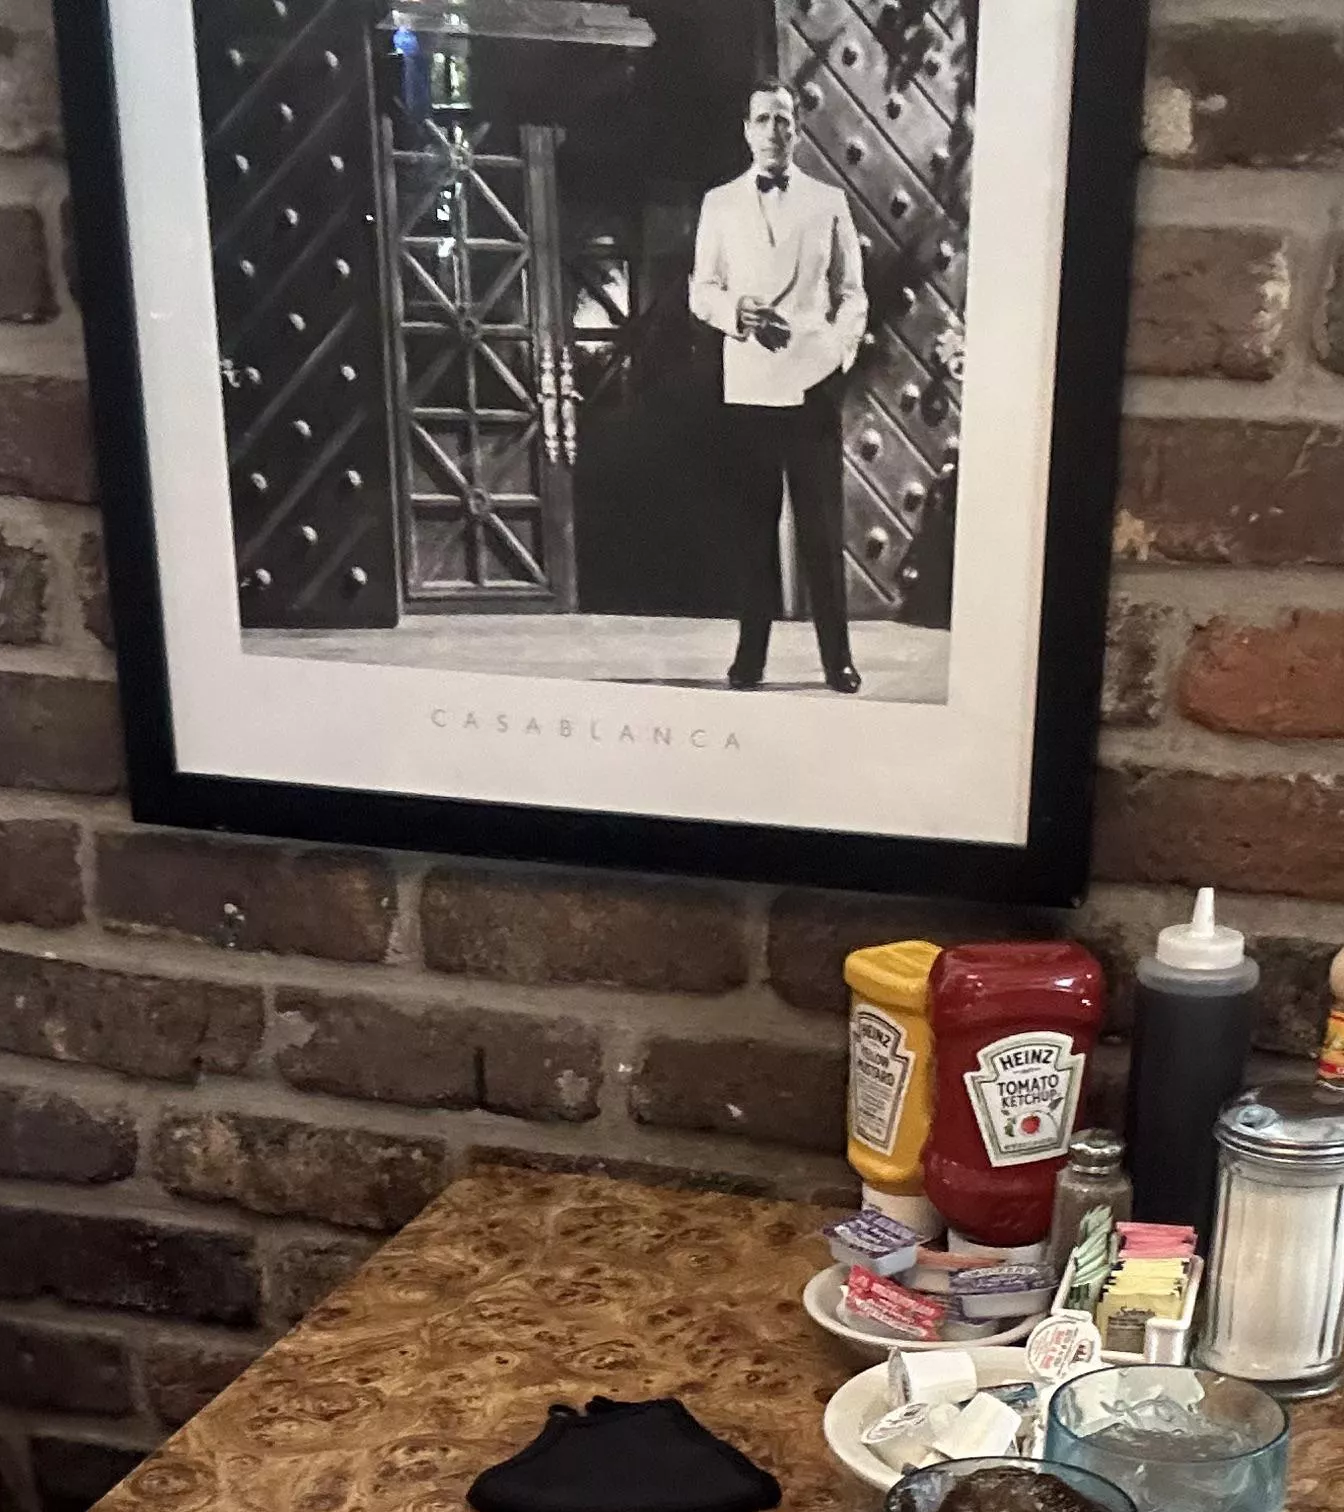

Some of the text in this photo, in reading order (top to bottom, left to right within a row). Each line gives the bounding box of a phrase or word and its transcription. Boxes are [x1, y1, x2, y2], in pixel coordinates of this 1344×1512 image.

[430, 708, 741, 751] CASABLANCA
[998, 1049, 1054, 1071] HEINZ
[997, 1074, 1060, 1097] TOMATO
[1001, 1089, 1058, 1109] KETCHUP
